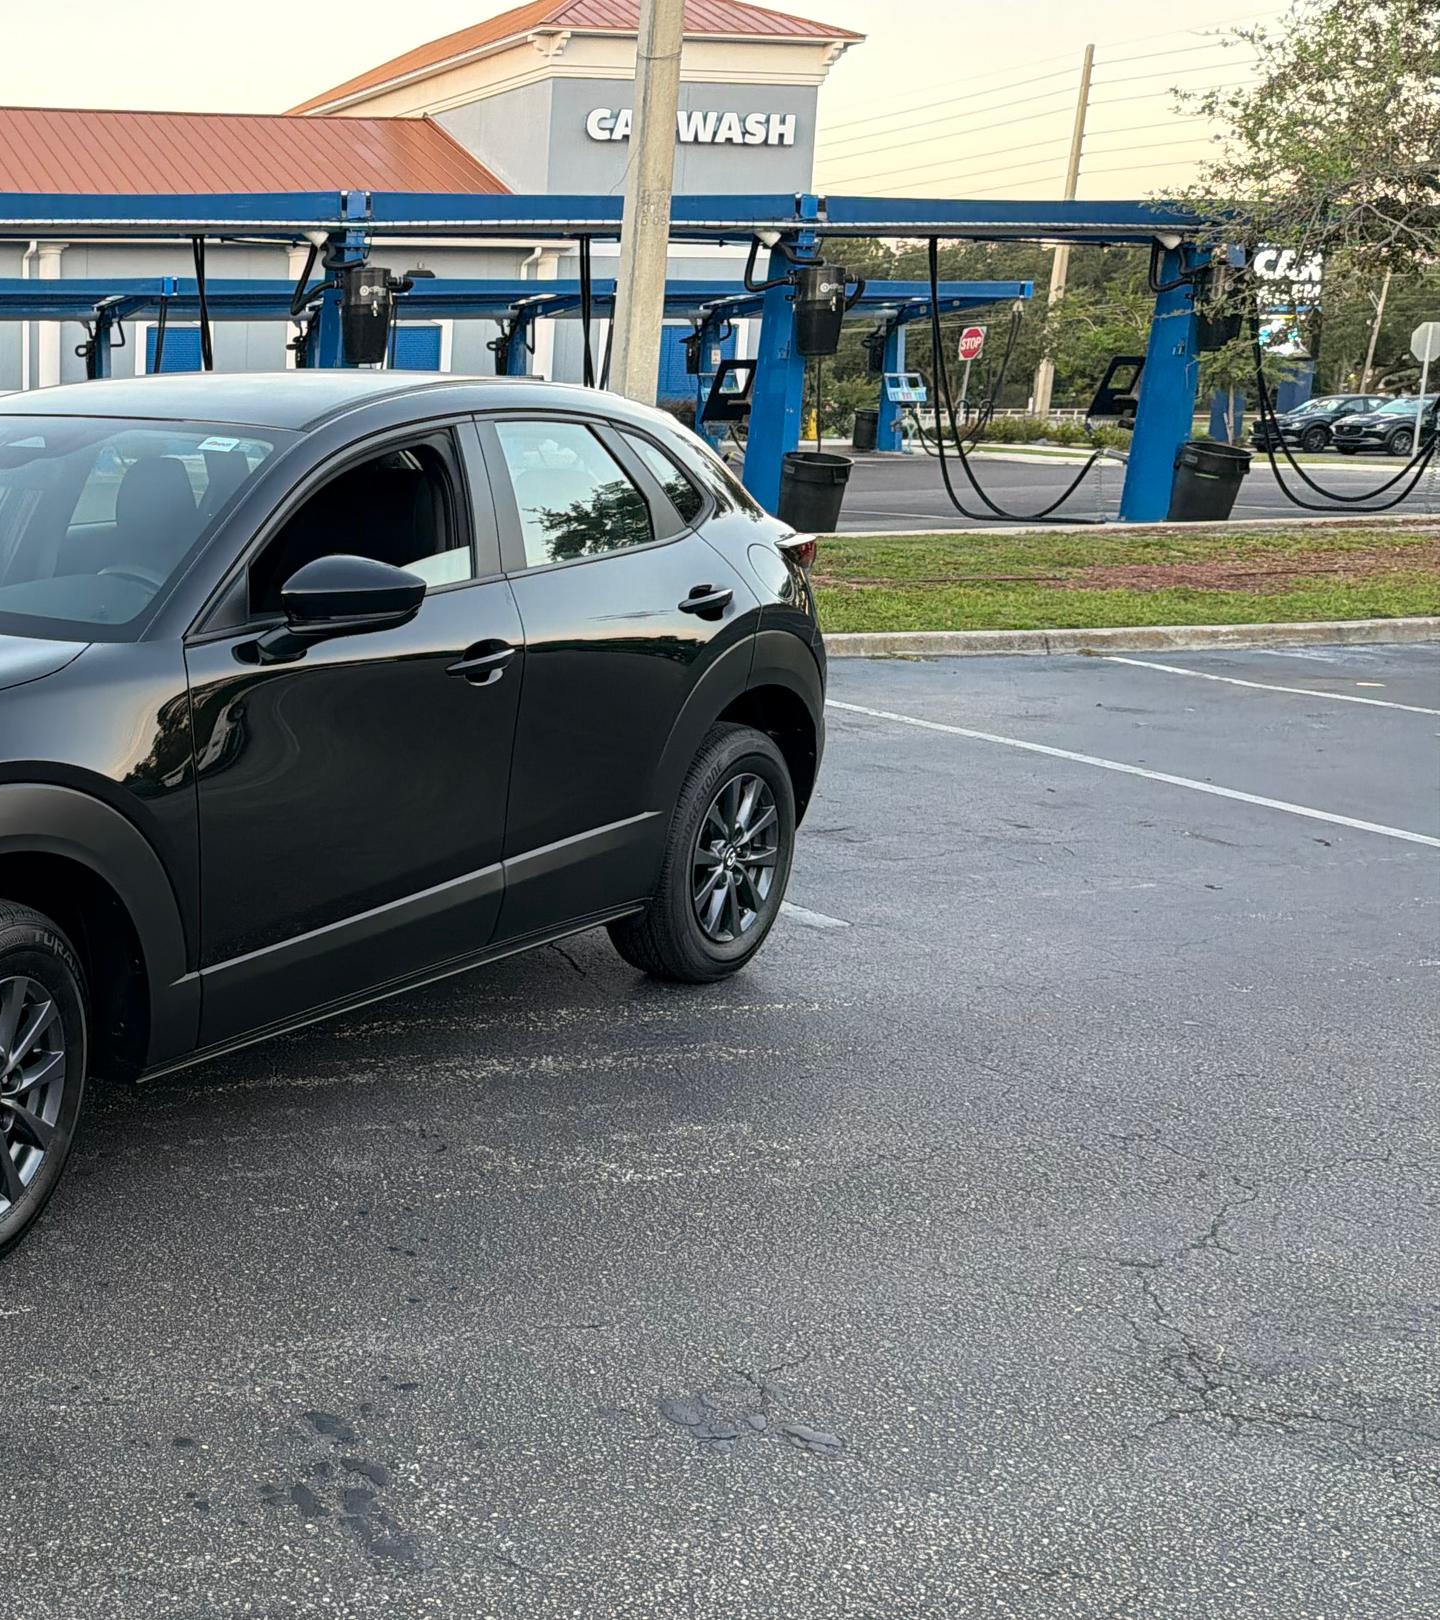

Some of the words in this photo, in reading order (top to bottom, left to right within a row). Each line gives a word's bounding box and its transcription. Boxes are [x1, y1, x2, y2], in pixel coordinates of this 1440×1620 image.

[586, 108, 632, 141] CA
[676, 110, 797, 145] WASH
[960, 336, 982, 351] STOP
